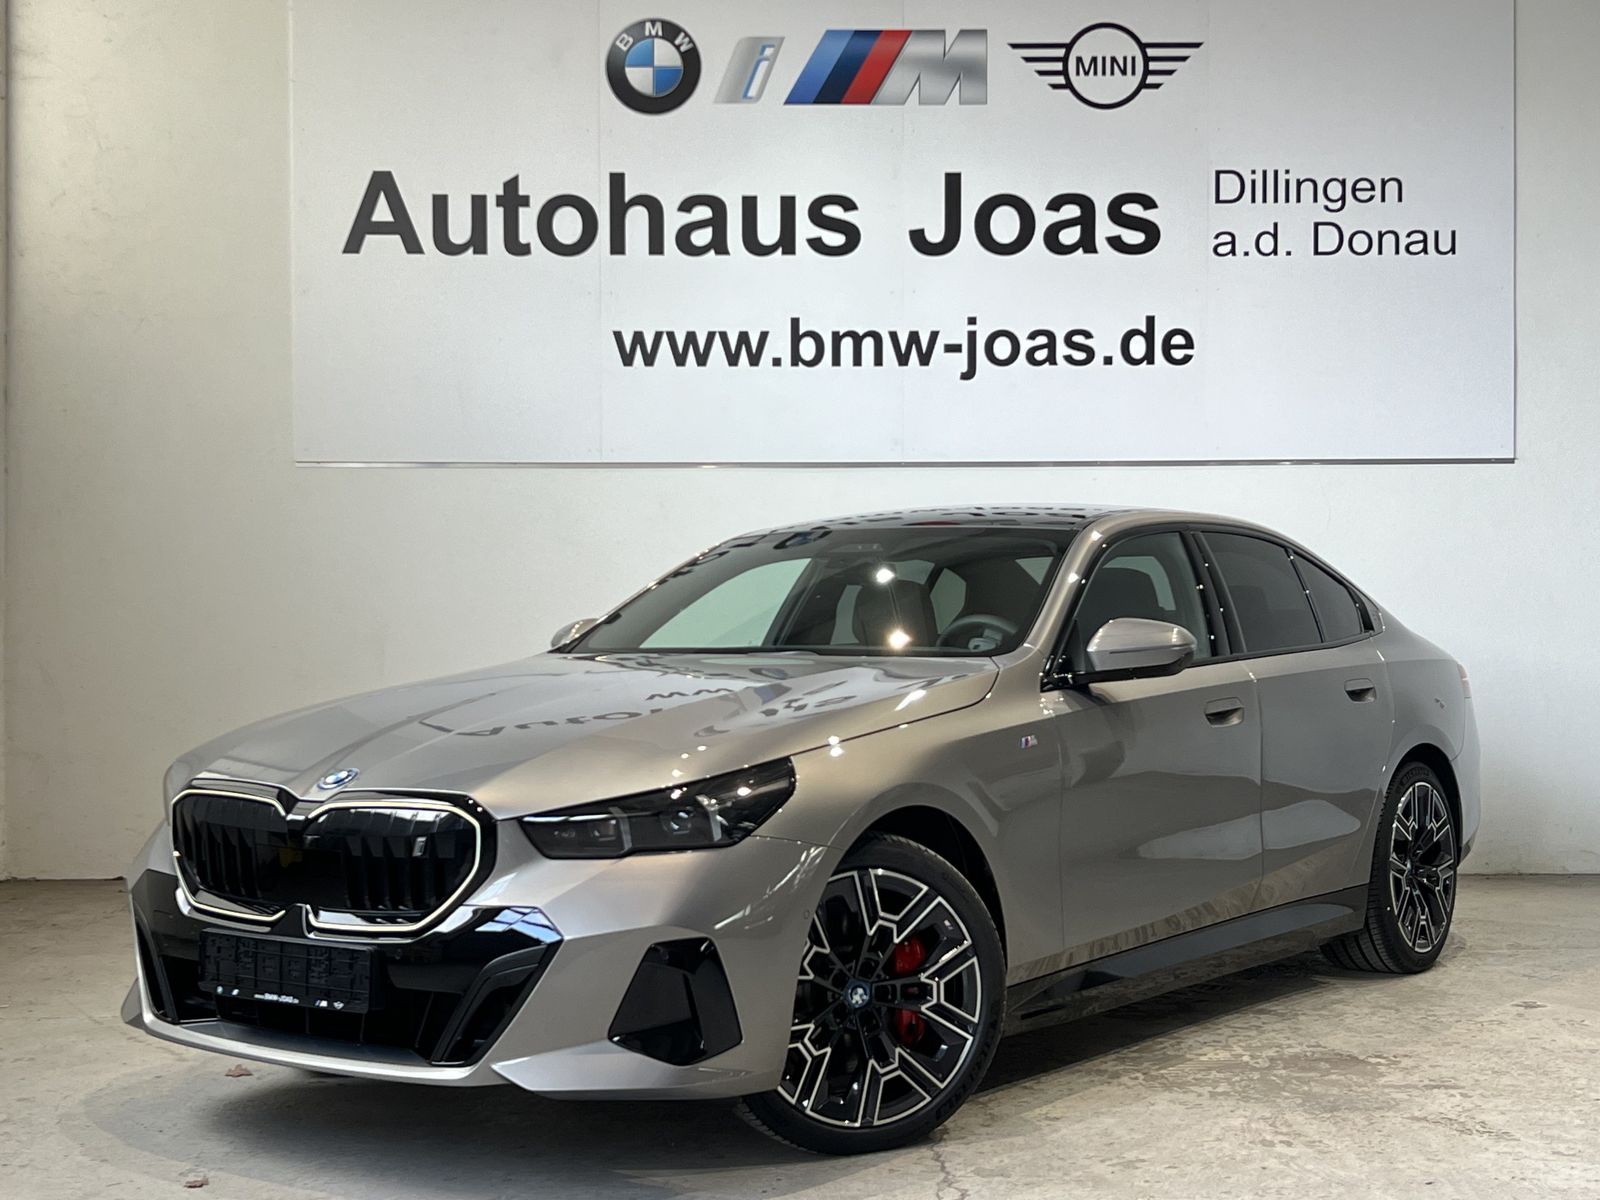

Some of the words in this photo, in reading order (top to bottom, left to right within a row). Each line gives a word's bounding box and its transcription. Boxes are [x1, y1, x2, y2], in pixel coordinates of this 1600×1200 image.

[615, 21, 694, 53] BMW
[868, 28, 989, 106] M
[1074, 54, 1138, 78] MINI
[1213, 168, 1404, 213] Dillingen
[342, 170, 863, 257] Autohaus
[908, 171, 1162, 257] Joas
[1211, 221, 1293, 258] a.d.
[1312, 221, 1457, 257] Donau
[612, 315, 1196, 381] www.bmw-joas.de
